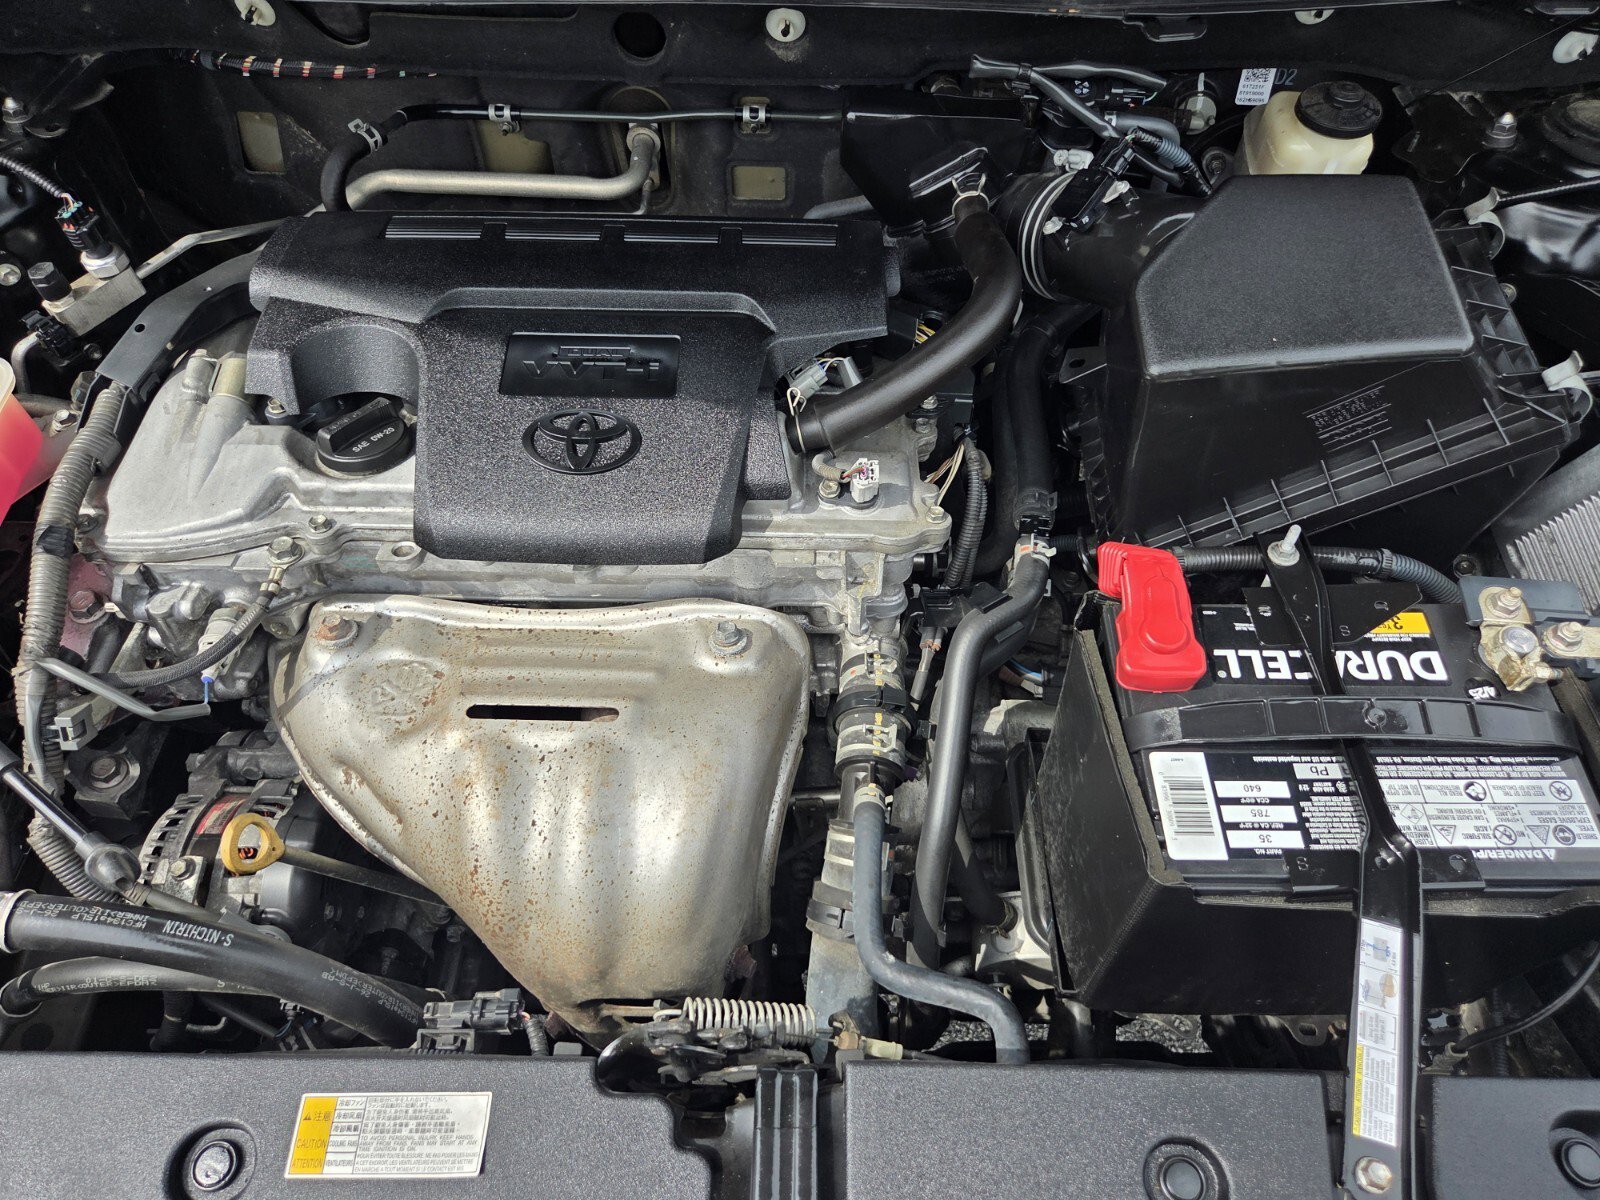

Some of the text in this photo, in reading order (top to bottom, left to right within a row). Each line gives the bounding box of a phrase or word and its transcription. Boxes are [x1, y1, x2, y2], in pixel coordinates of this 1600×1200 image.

[352, 427, 395, 453] SAE 0W-20
[1310, 766, 1329, 776] Pb
[1244, 784, 1261, 792] 640
[1250, 809, 1270, 818] 785
[1258, 834, 1272, 843] 35
[1471, 849, 1544, 859] DANGER/P
[1296, 857, 1309, 871] S
[297, 1138, 326, 1149] CAUTION
[293, 1158, 322, 1168] ATTENTION
